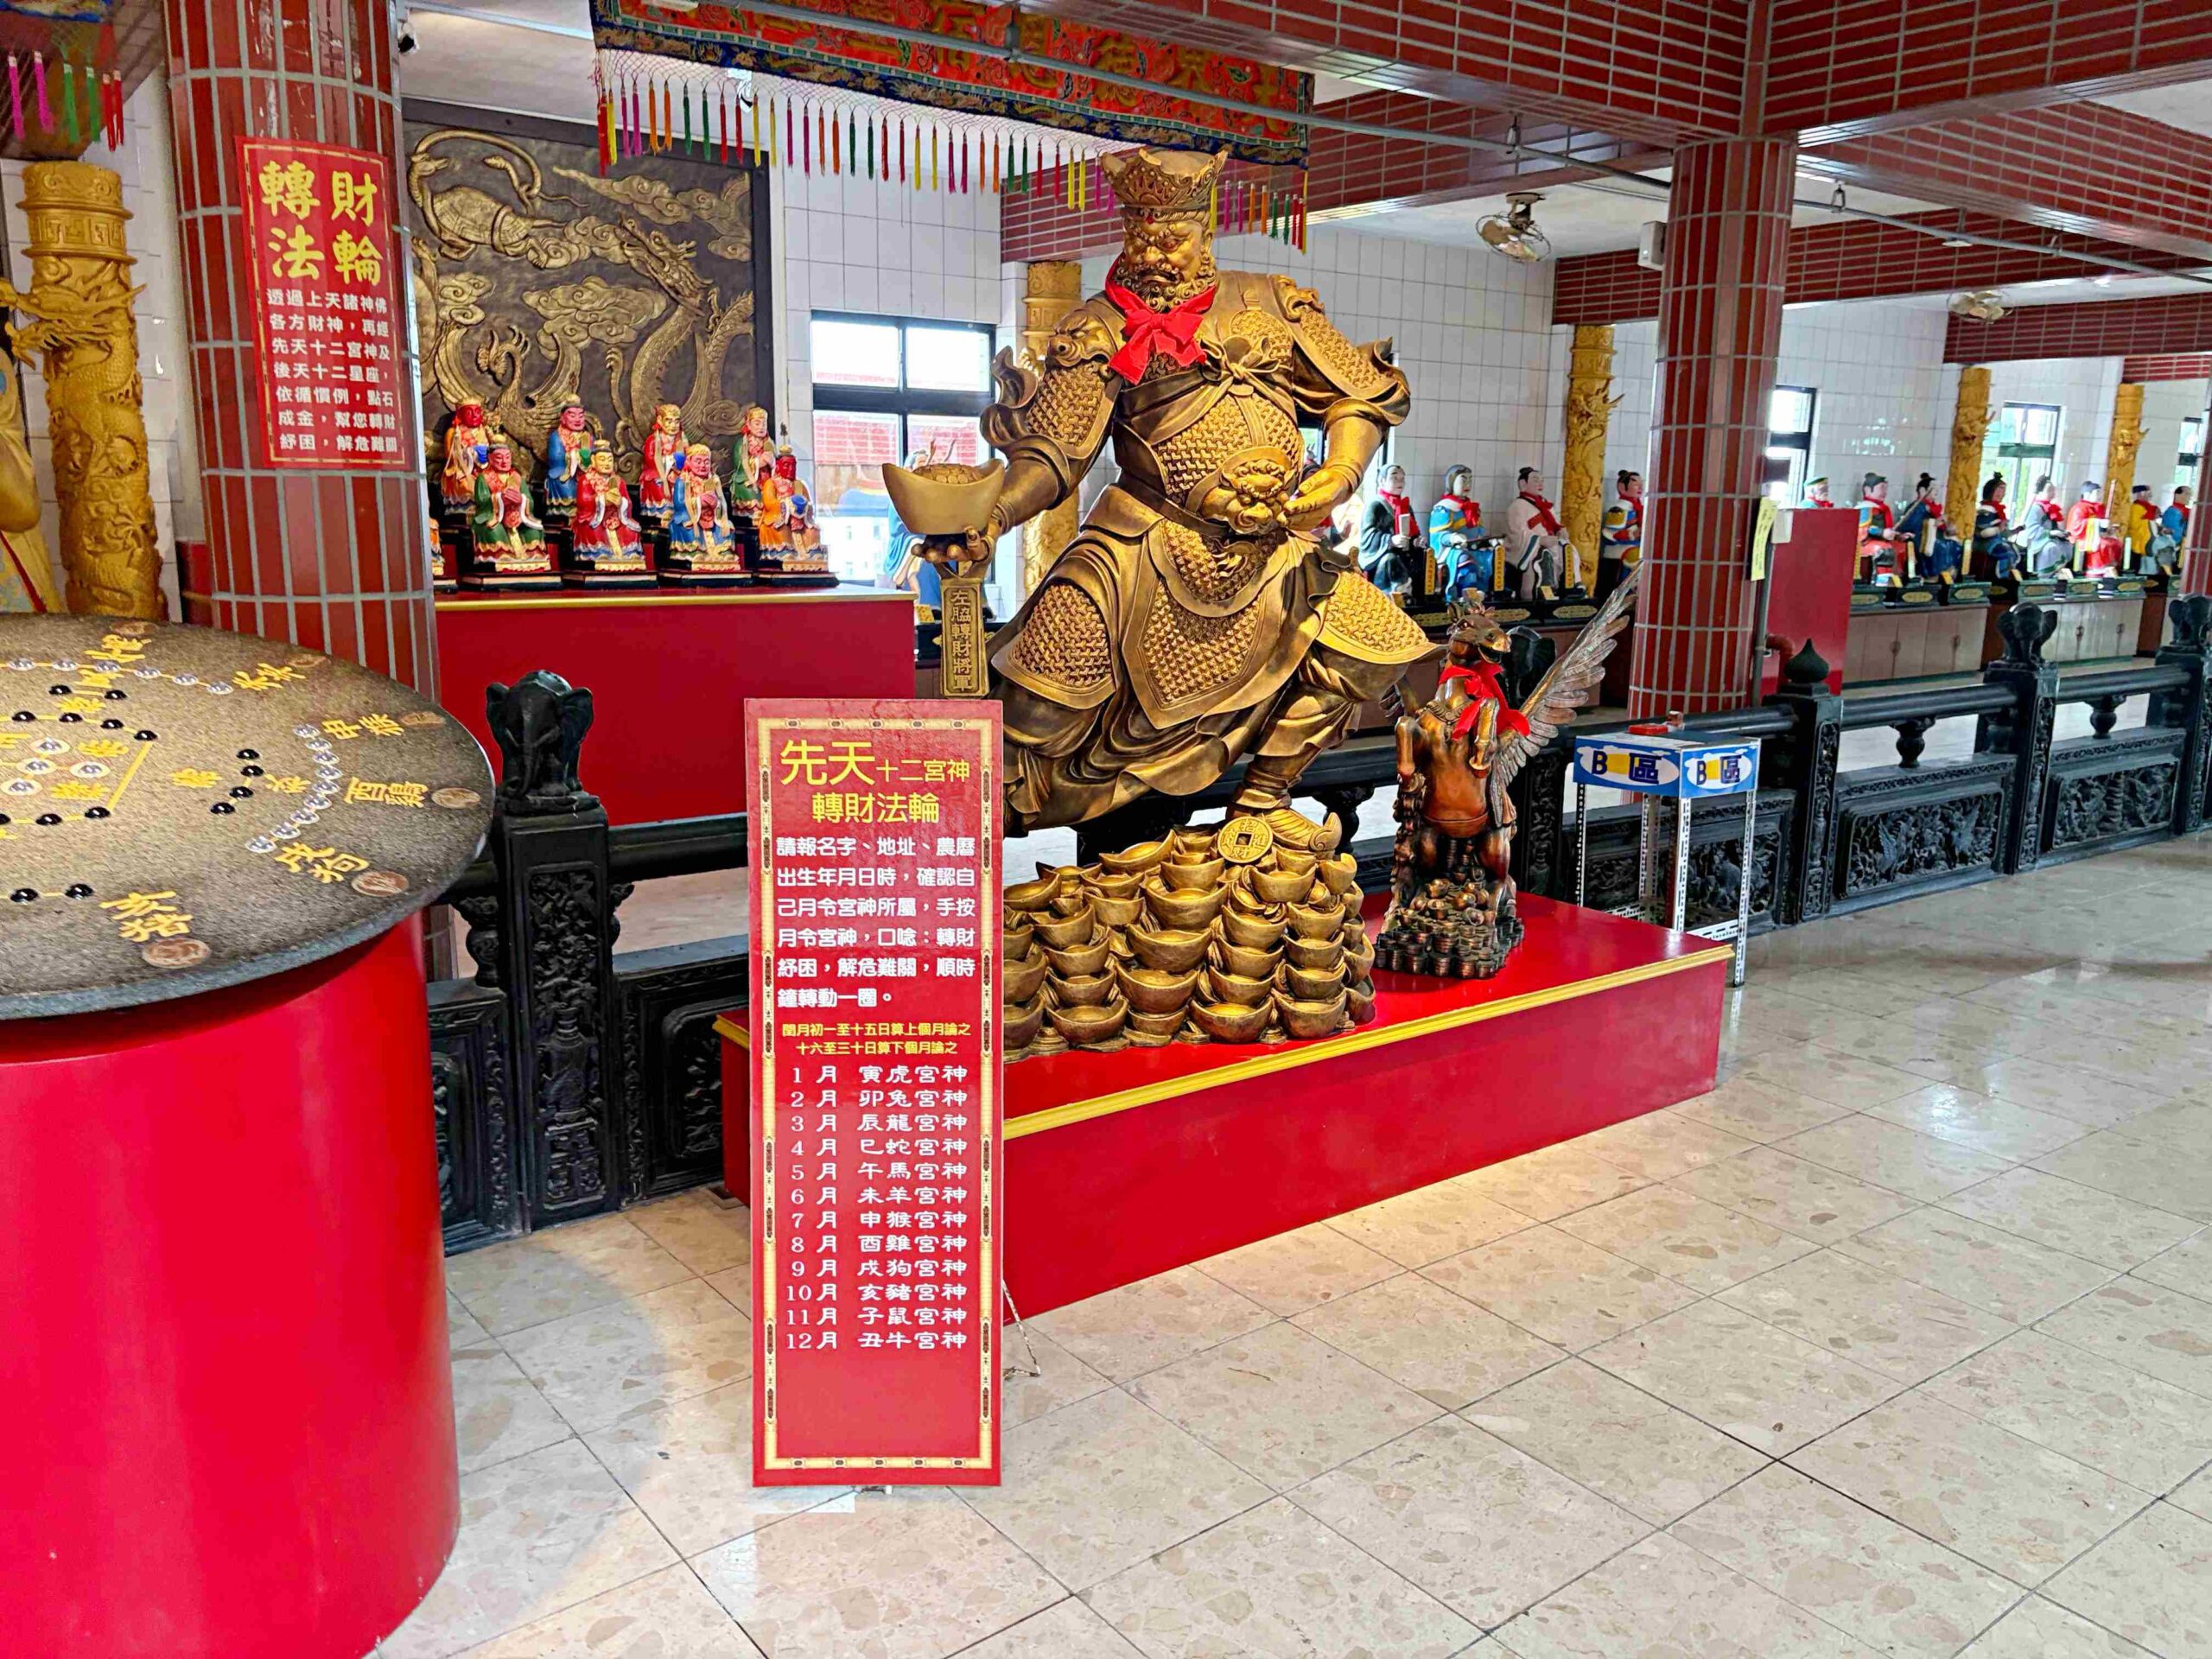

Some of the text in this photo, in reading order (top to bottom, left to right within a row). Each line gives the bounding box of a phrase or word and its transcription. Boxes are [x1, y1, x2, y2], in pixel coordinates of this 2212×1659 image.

[258, 159, 378, 228] 轉財
[266, 224, 383, 286] 法輪
[265, 288, 388, 315] 透過上天諸神佛
[779, 739, 970, 785] 先天十二宮神
[1592, 750, 1662, 784] B 區
[1696, 754, 1742, 785] B 區
[811, 791, 940, 824] 轉財法輪
[777, 866, 976, 887] 出生年月日時，確認自
[777, 896, 976, 918] 己月令宮神所屬，手按
[796, 1040, 957, 1055] 十六至三十日算下個月論之
[858, 1065, 968, 1084] 寅虎宮神
[858, 1089, 968, 1108] 卯兔宮神
[856, 1113, 968, 1132] 辰龍宮神
[860, 1137, 968, 1156] 巳蛇宮神
[857, 1161, 968, 1180] 午馬宮神
[857, 1185, 968, 1205] 未羊宮神
[860, 1210, 968, 1229] 申猴宮神
[858, 1234, 968, 1253] 酉雞宮神
[856, 1258, 968, 1277] 戌狗宮神
[857, 1282, 968, 1301] 亥豬宮神
[857, 1306, 968, 1325] 子鼠宮神
[857, 1331, 967, 1350] 丑牛宮神
